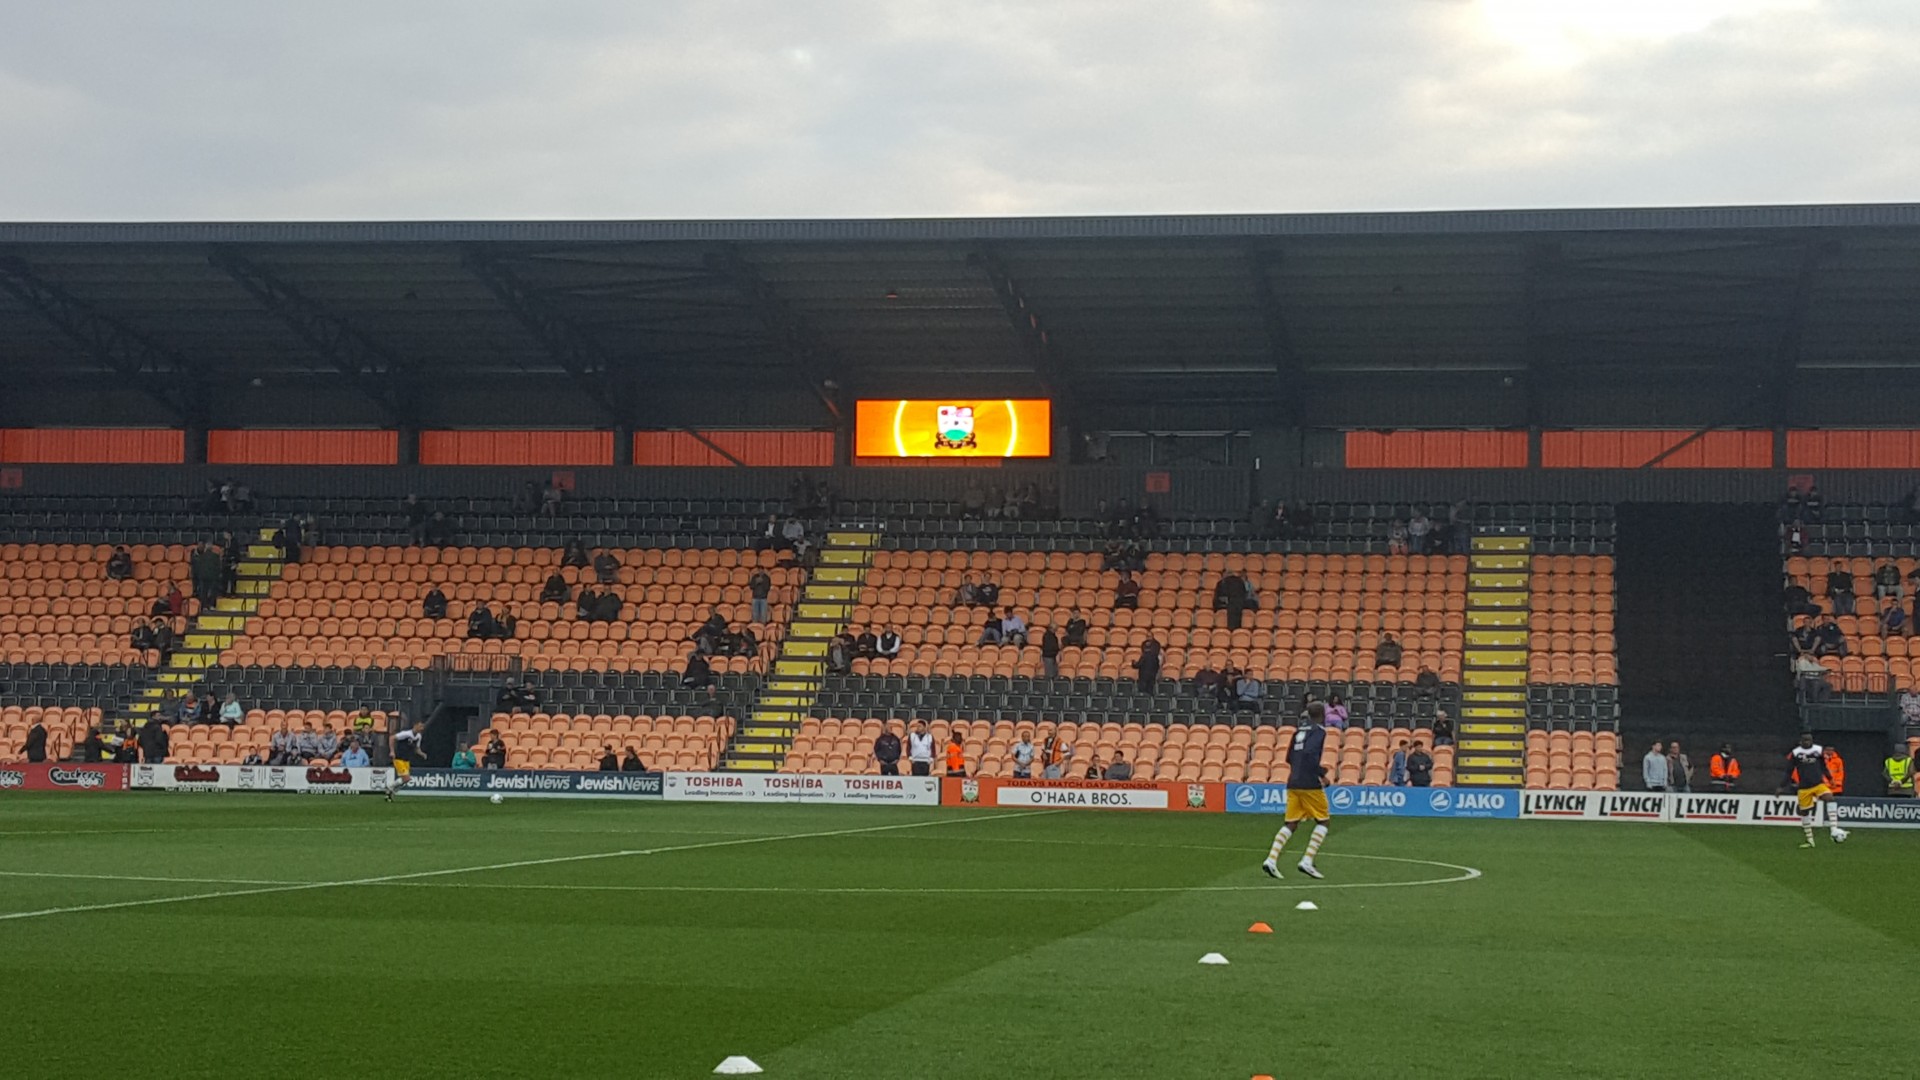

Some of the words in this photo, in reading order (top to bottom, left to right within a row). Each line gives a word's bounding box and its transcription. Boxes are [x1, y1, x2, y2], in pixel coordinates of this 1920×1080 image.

[404, 773, 481, 788] ewishNews
[685, 776, 743, 788] TOSHIBA
[764, 778, 823, 789] TOSHIBA
[845, 779, 903, 790] TOSHIBA
[1048, 780, 1083, 788] MATCH
[1086, 781, 1105, 789] DAY
[1108, 781, 1159, 790] SPONSOR
[1030, 791, 1087, 804] O'HARA
[1091, 792, 1133, 806] BROS.
[1260, 788, 1287, 804] JA
[1357, 790, 1406, 807] JAKO
[1455, 793, 1505, 809] JAKO
[1535, 794, 1586, 811] LYNCH
[1610, 796, 1663, 812] LYNCH
[1687, 798, 1740, 815] LYNCH
